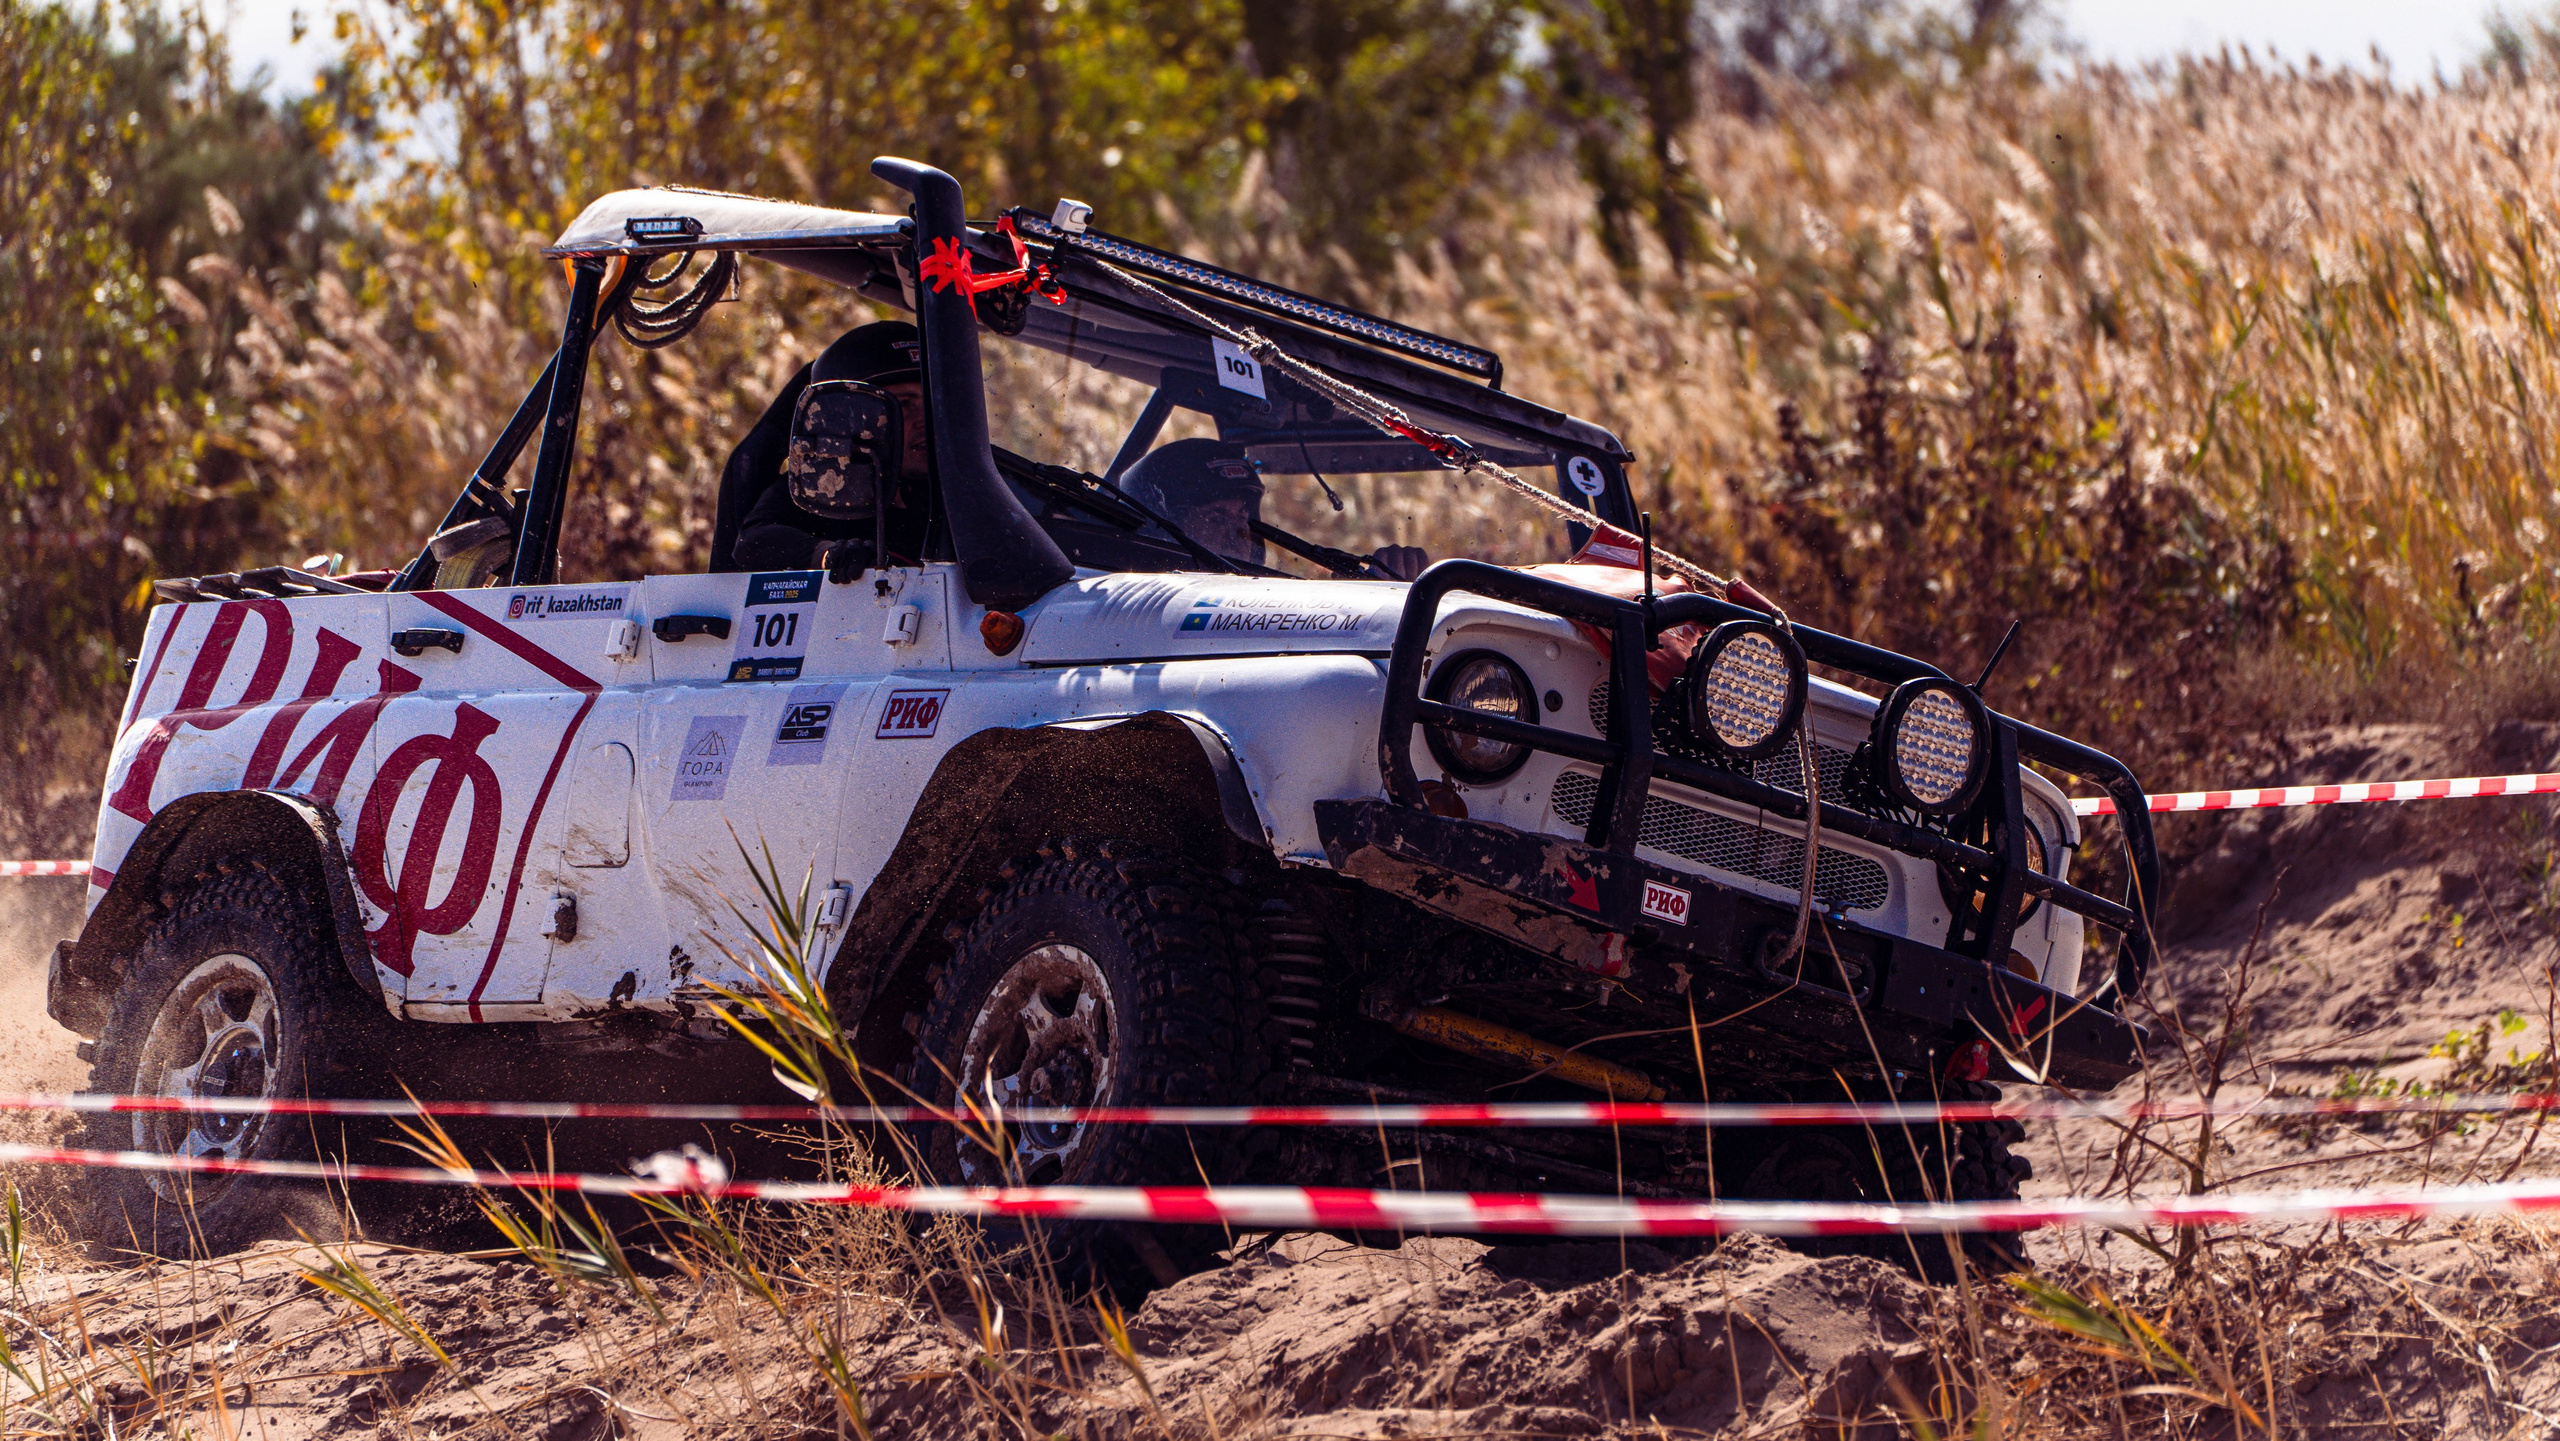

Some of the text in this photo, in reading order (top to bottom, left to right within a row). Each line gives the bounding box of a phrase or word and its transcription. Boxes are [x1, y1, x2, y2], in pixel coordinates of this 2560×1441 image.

[1224, 355, 1254, 379] 101
[763, 580, 808, 591] КАПЧАГАЙСКАЯ
[525, 594, 623, 618] rif_kazakhstan
[753, 613, 799, 647] 101
[1211, 613, 1365, 631] МАКАРЕНКО М.
[782, 705, 832, 727] ASP
[881, 697, 939, 729] РИФ
[681, 761, 723, 775] ГОРА
[109, 600, 501, 980] РИФ
[1645, 886, 1686, 917] РИФ
